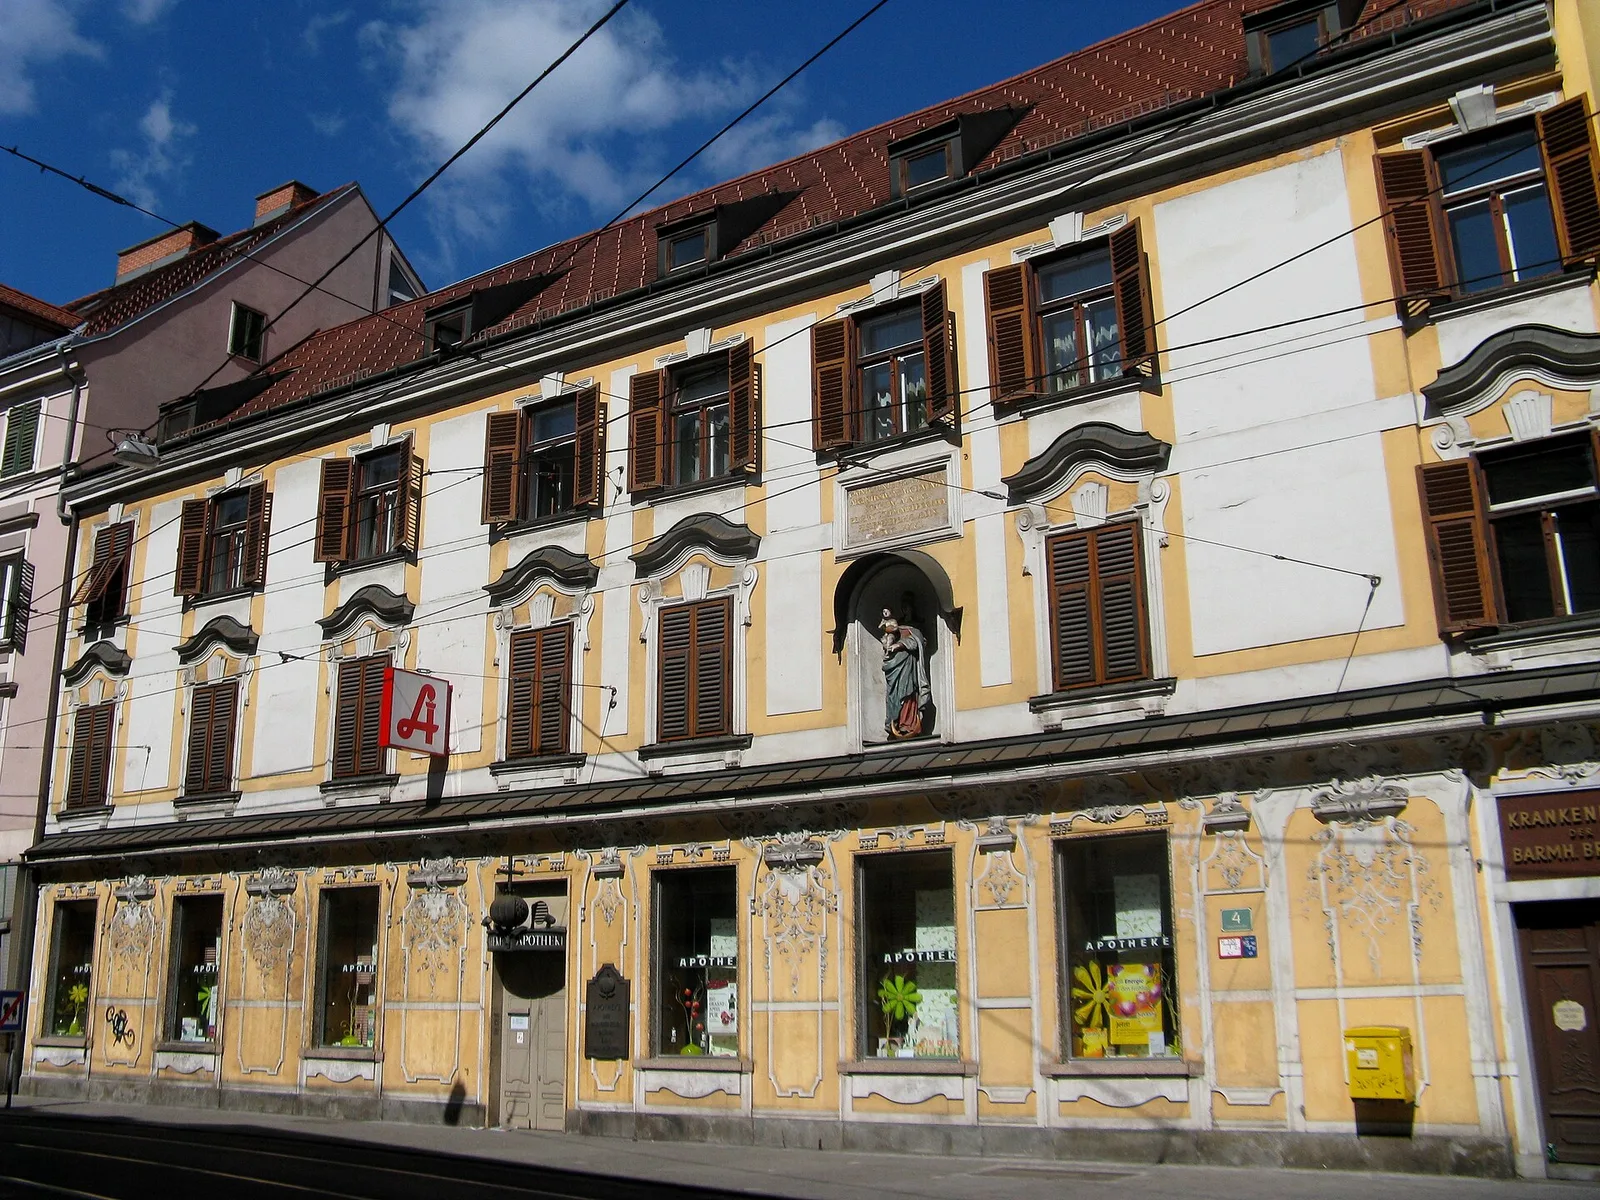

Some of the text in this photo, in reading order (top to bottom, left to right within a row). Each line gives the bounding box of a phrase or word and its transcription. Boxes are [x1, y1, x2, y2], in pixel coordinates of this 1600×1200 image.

[1508, 806, 1600, 827] KRANKEN
[1569, 828, 1593, 838] DER
[1231, 911, 1241, 924] 4
[1086, 937, 1170, 951] APOTHEKE
